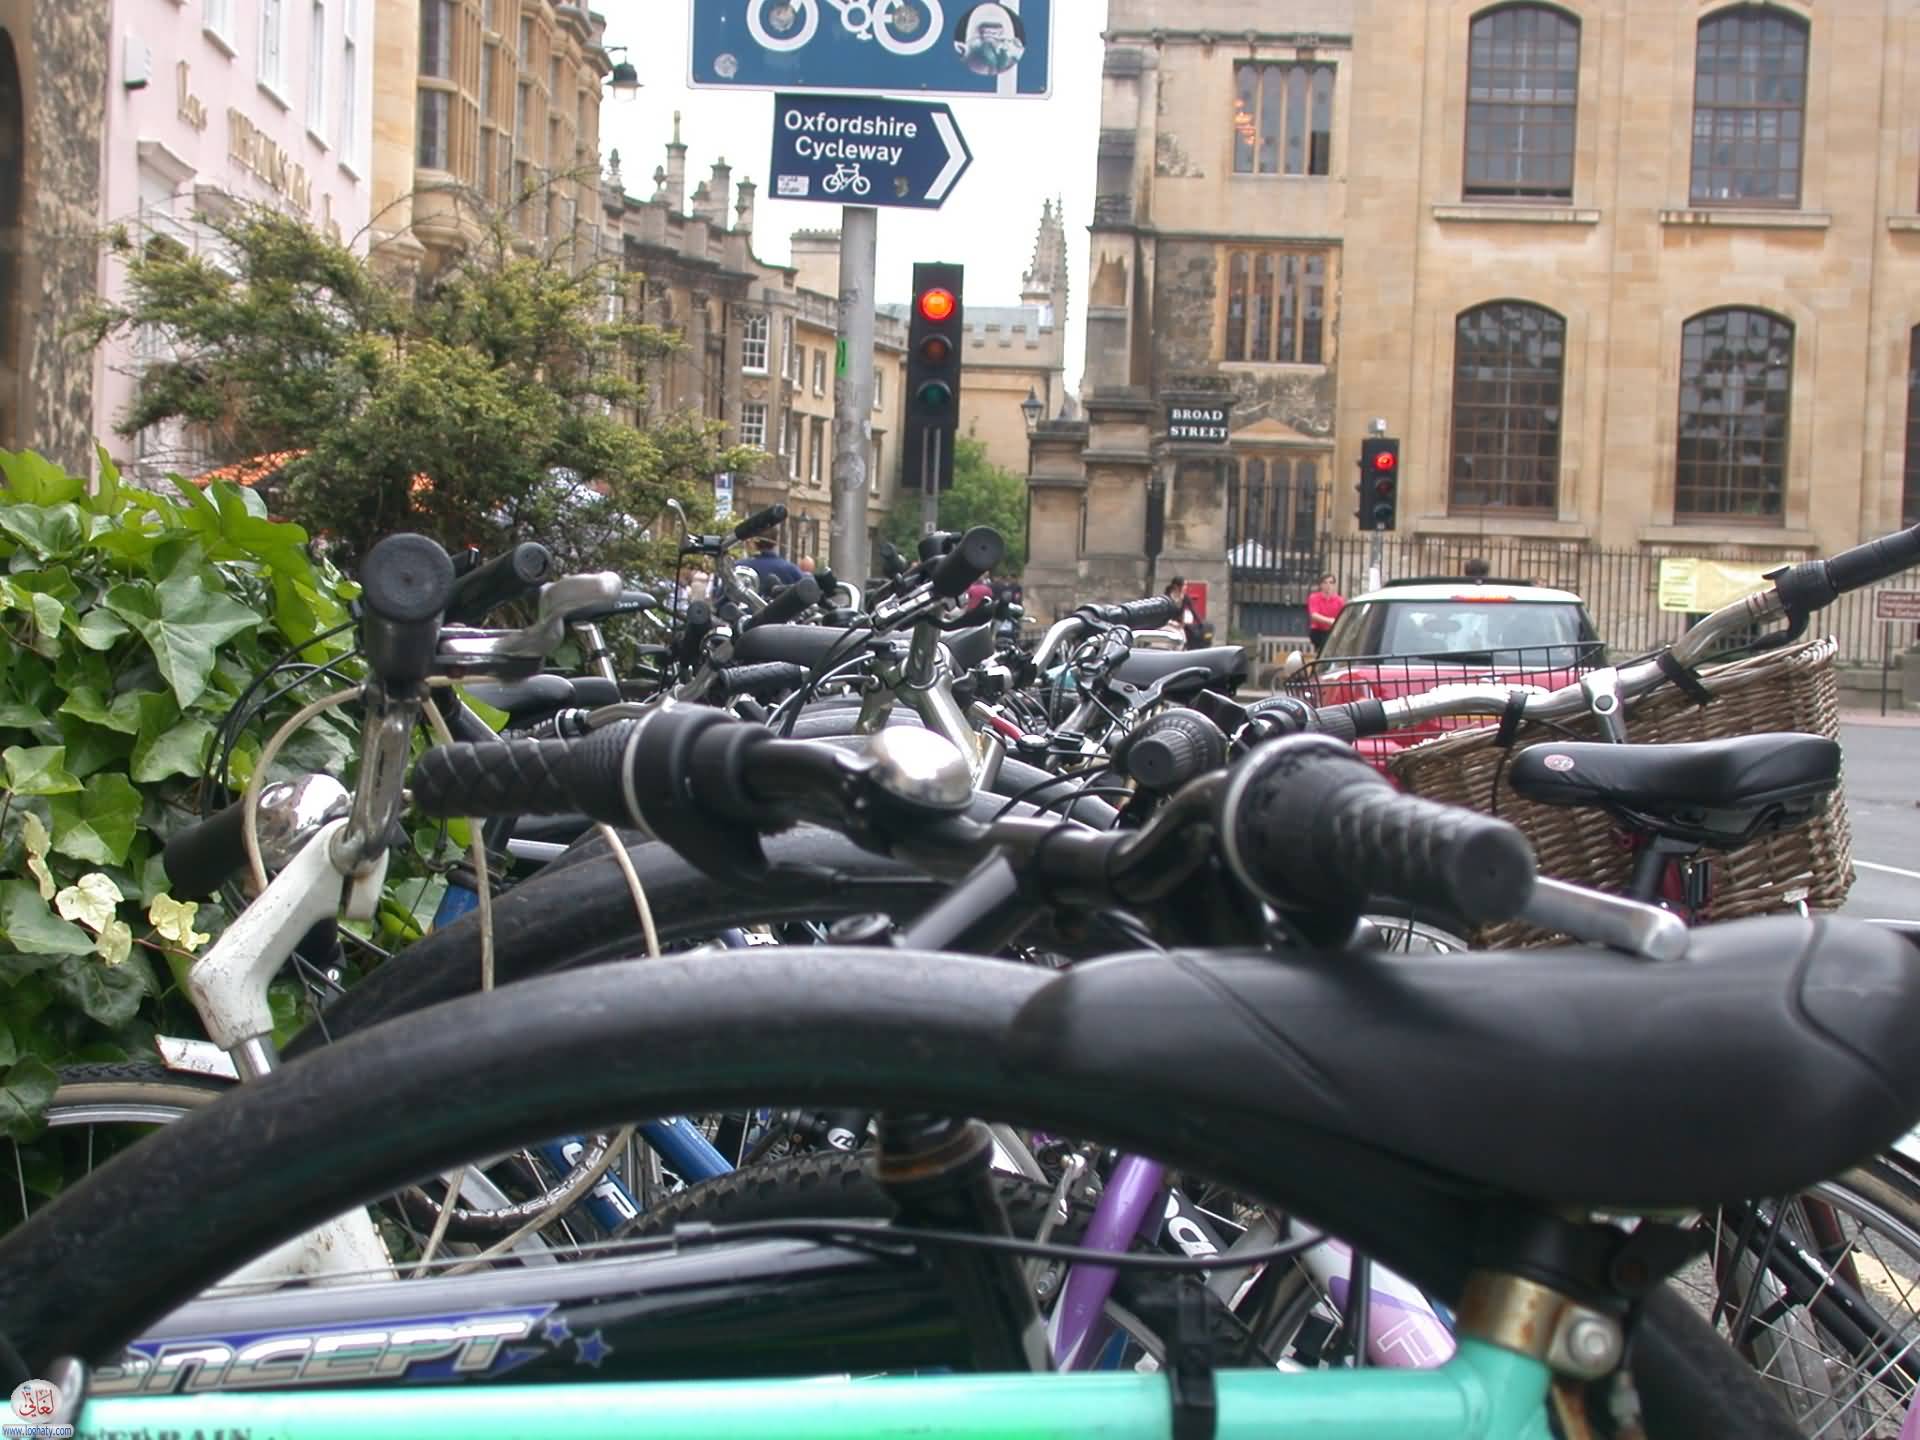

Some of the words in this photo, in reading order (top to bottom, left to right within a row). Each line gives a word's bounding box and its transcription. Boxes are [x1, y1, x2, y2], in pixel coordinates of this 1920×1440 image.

[784, 110, 917, 137] Oxfordshire
[795, 136, 902, 165] Cycleway
[1172, 408, 1223, 421] BROAD
[1170, 426, 1227, 438] STREET
